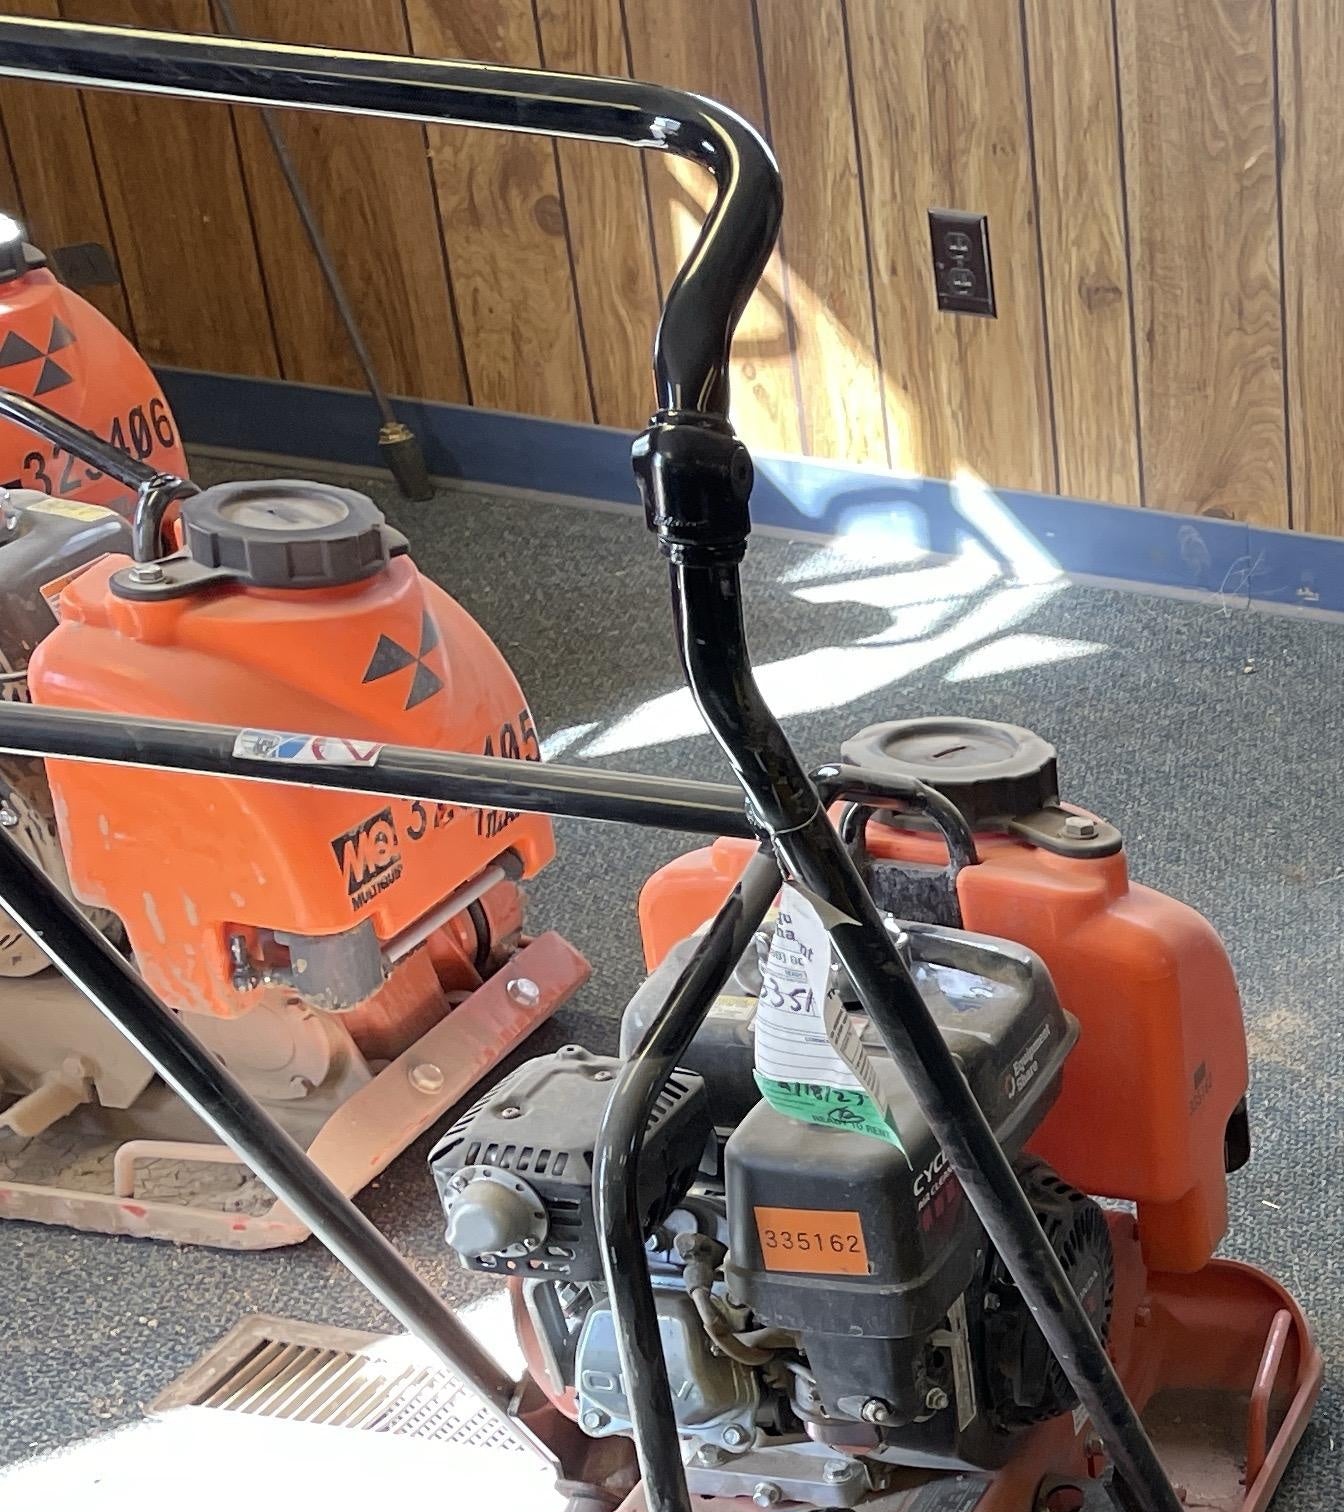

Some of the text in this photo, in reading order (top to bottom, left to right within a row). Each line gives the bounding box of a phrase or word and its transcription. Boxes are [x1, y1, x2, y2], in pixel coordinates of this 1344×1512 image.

[23, 397, 176, 495] 32406
[1016, 1060, 1039, 1093] Share
[764, 1228, 861, 1253] 335162
